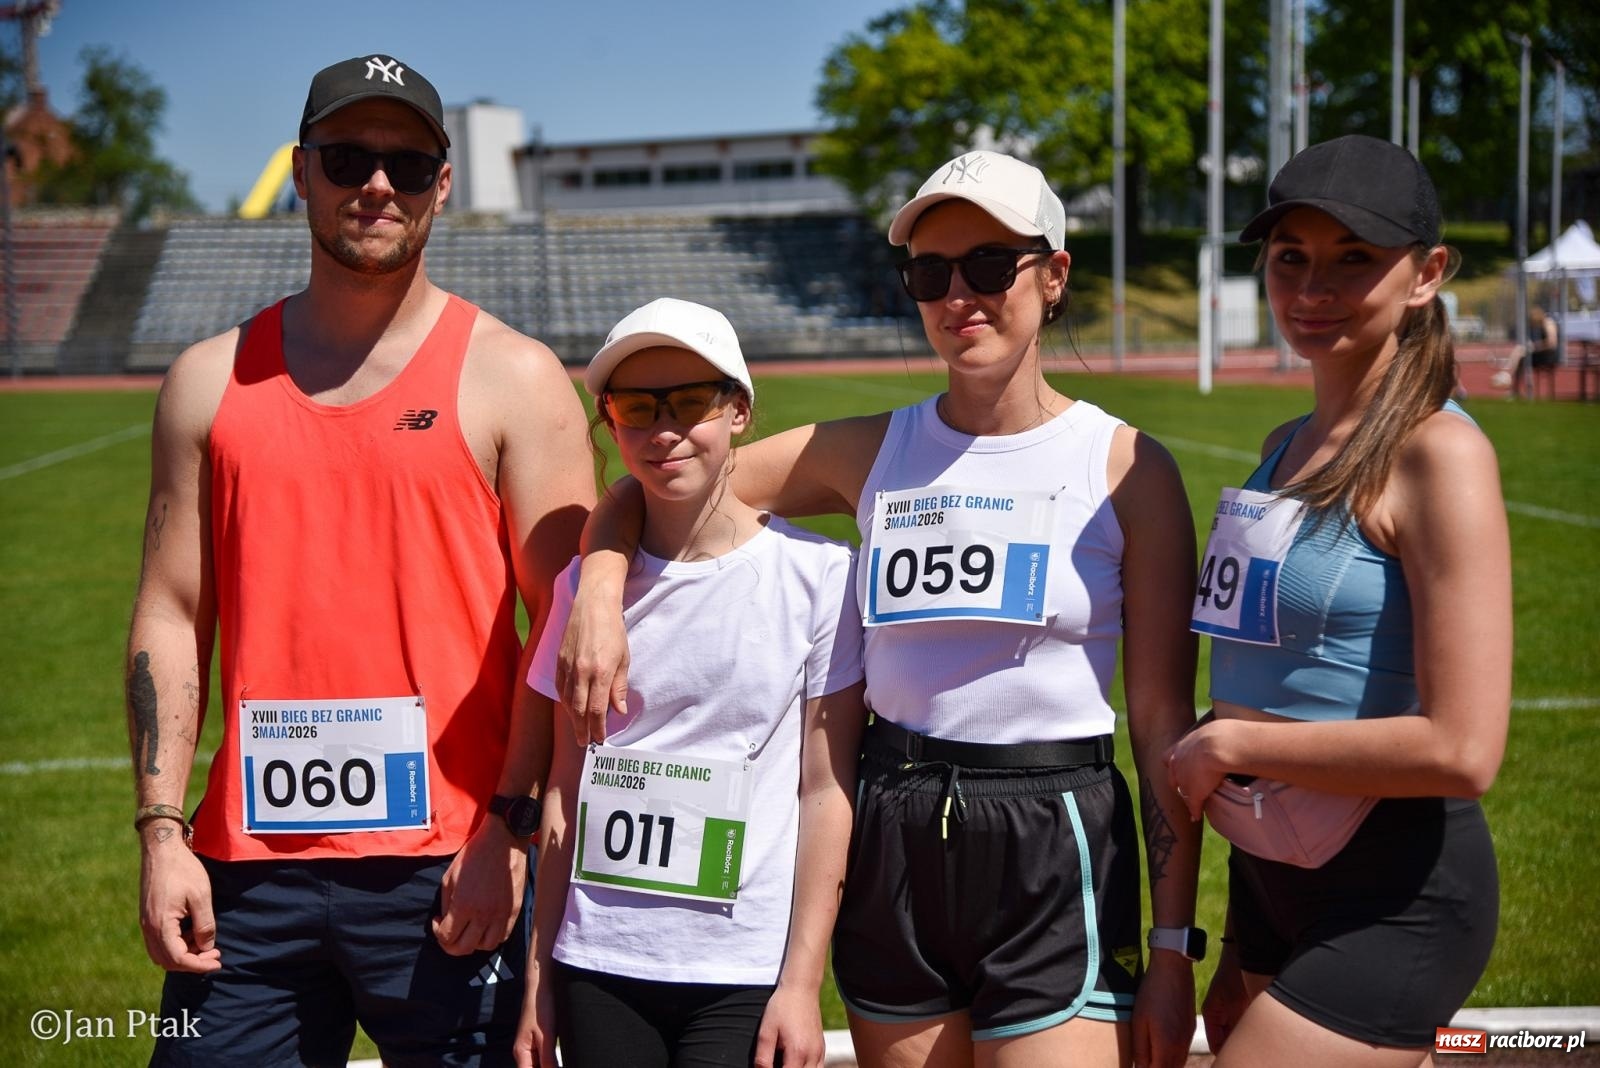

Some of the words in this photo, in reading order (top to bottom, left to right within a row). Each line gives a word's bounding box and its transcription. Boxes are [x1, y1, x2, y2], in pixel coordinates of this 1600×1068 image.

[886, 500, 910, 515] XVIII
[913, 498, 937, 512] BIEG
[941, 495, 961, 509] BEZ
[965, 495, 1014, 512] GRANIC
[1229, 501, 1267, 521] GRANIC
[886, 544, 995, 598] 059
[251, 710, 278, 723] XVIII
[281, 709, 308, 723] BIEG
[311, 709, 333, 723] BEZ
[336, 708, 382, 722] GRANIC
[593, 756, 616, 771] XVIII
[617, 758, 640, 773] BIEG
[642, 761, 662, 776] BEZ
[665, 763, 712, 782] GRANIC
[263, 758, 376, 808] 060
[604, 810, 675, 868] 011
